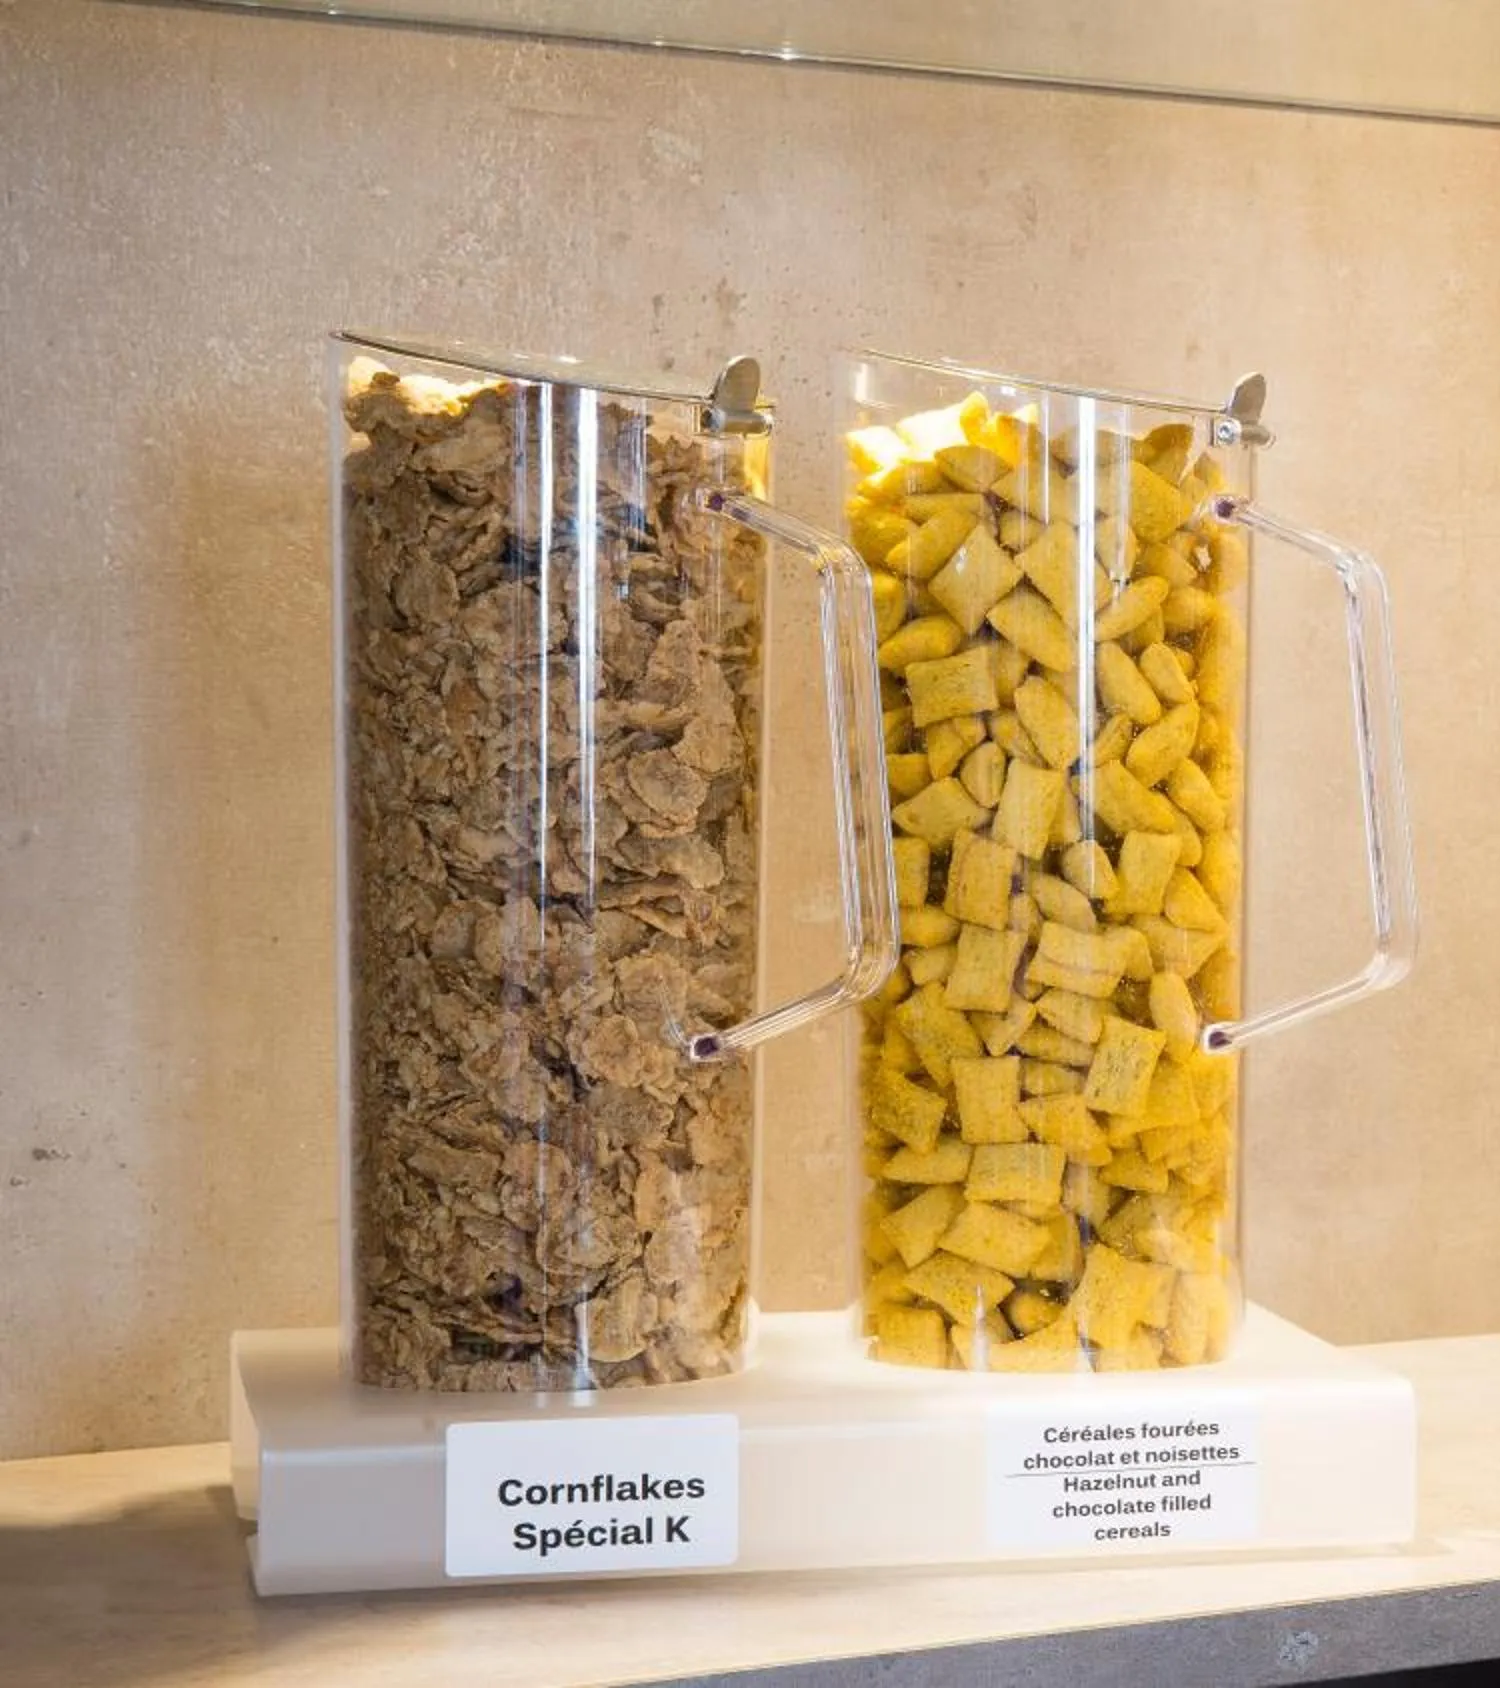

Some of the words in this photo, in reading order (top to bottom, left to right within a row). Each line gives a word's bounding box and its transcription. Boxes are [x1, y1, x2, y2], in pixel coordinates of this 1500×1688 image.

[1044, 1425, 1135, 1444] Céréales
[1141, 1420, 1219, 1439] fourées
[1024, 1451, 1115, 1470] chocolat
[1120, 1450, 1139, 1465] et
[1145, 1445, 1239, 1463] noisettes
[498, 1474, 705, 1506] Cornflakes
[1064, 1472, 1156, 1492] Hazelnut
[1162, 1470, 1201, 1487] and
[1053, 1499, 1155, 1518] chocolate
[1161, 1494, 1212, 1512] filled
[513, 1516, 652, 1556] Spécial
[666, 1516, 690, 1542] K
[1094, 1522, 1171, 1541] cereals
